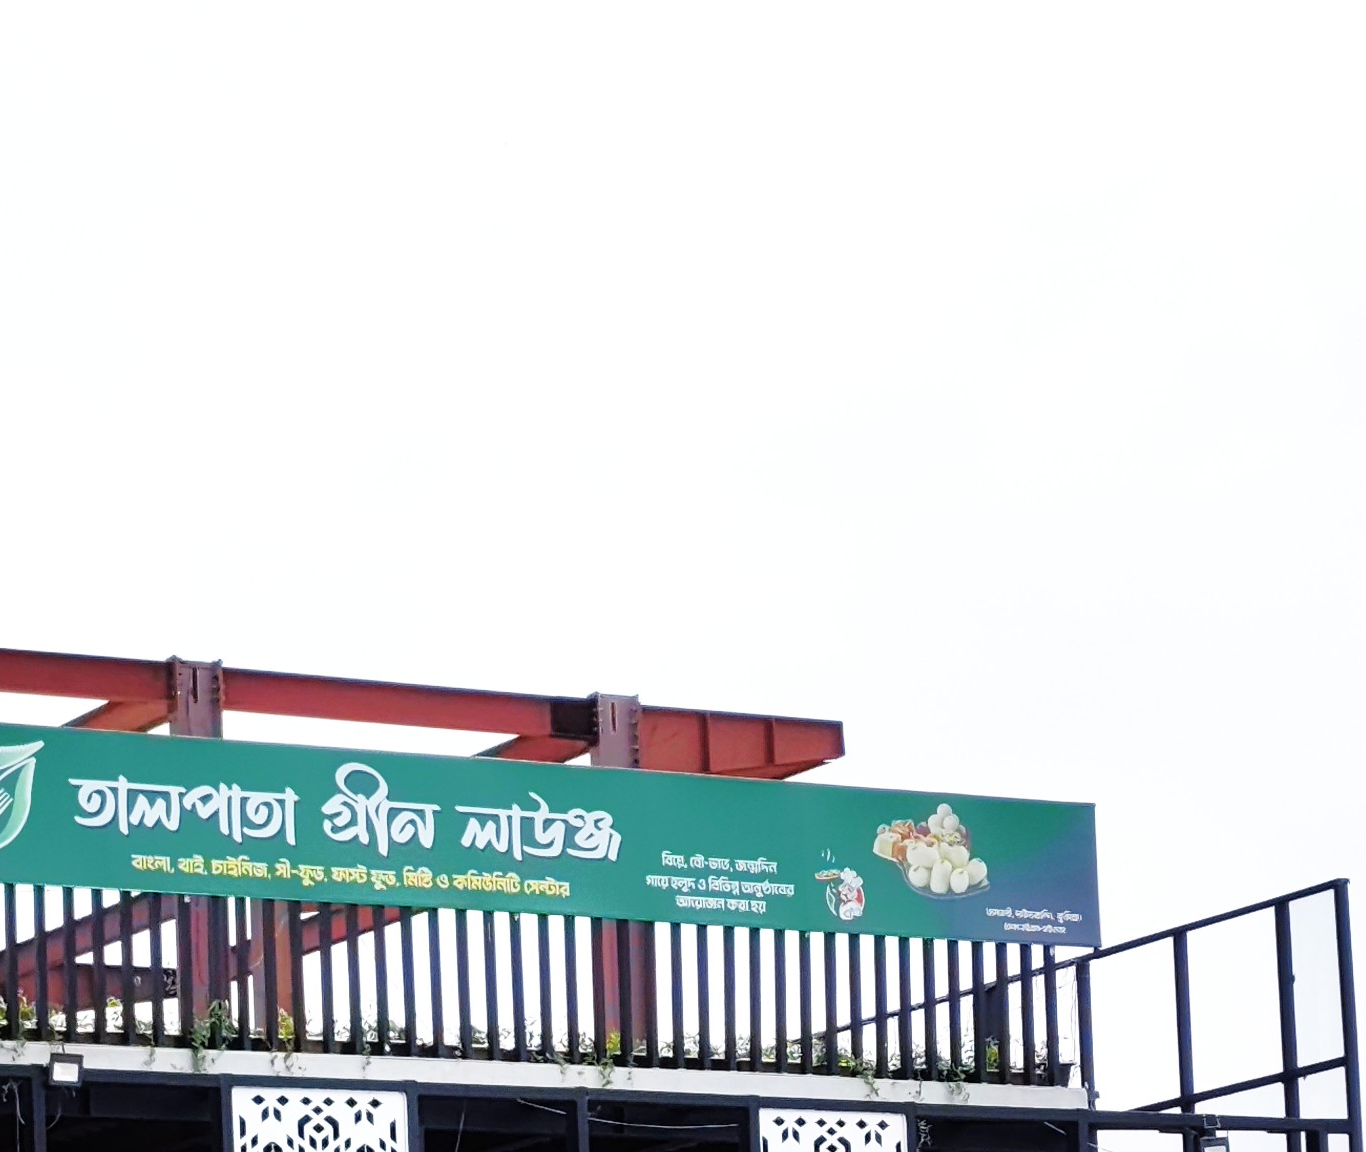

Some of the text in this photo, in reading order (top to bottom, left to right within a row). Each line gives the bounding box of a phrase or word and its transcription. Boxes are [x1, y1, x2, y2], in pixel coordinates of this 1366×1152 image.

[68, 761, 623, 861] তালপাতা গ্রীন লাউঞ্জ
[131, 854, 175, 874] বাংলা,
[211, 855, 271, 880] চাইনিজ,
[331, 864, 367, 884] ফাস্ট
[436, 873, 449, 889] ও
[452, 869, 521, 893] কমিউনিটি
[524, 877, 570, 898] সেন্টার
